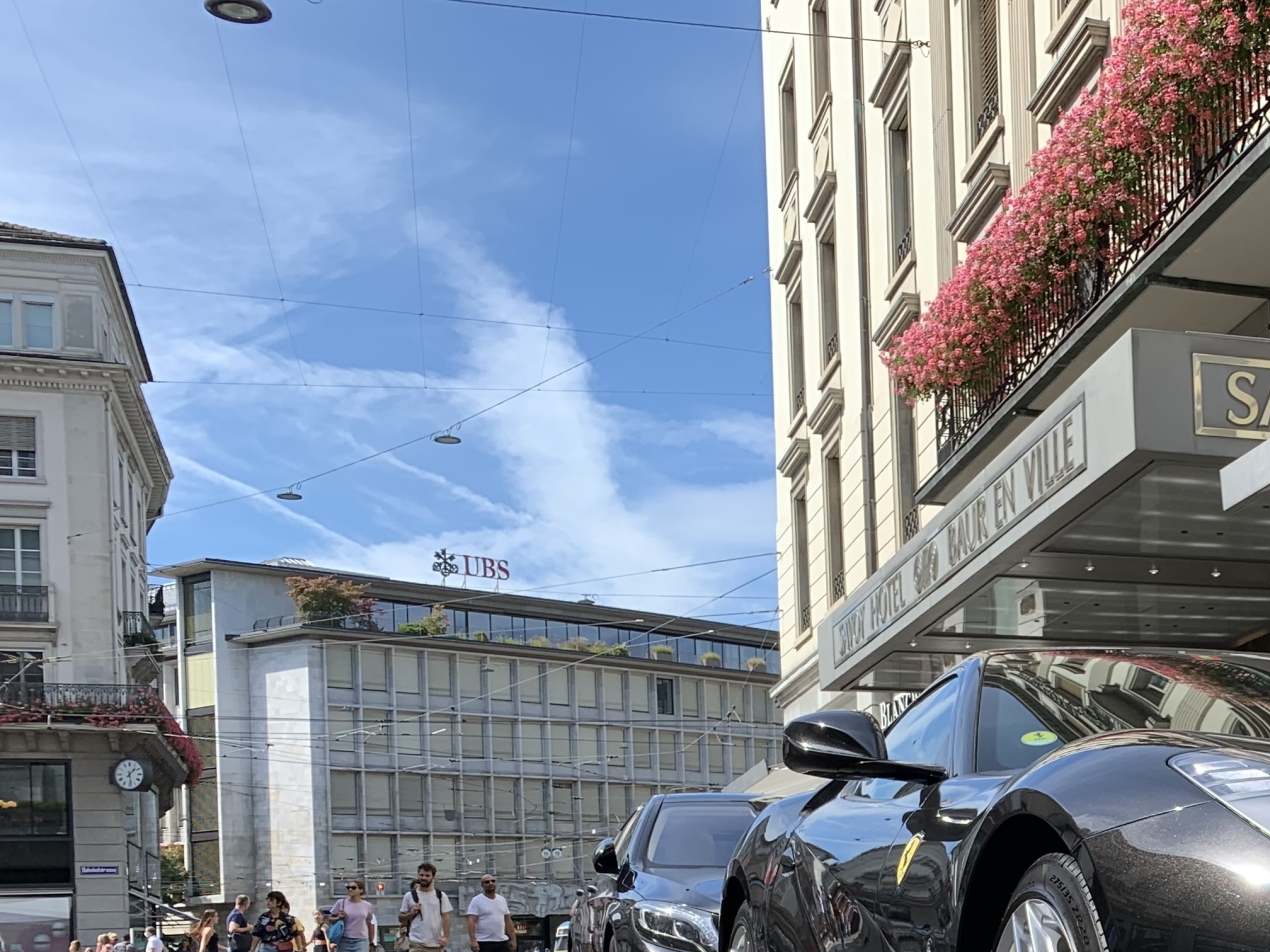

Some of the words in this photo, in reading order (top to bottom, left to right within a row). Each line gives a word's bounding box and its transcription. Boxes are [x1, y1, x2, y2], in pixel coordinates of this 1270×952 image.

[463, 554, 510, 580] UBS
[839, 603, 866, 657] SAVOY
[870, 569, 906, 624] HOTEL
[947, 495, 989, 568] BAUR
[993, 467, 1017, 531] EN
[1022, 413, 1075, 502] VILLE
